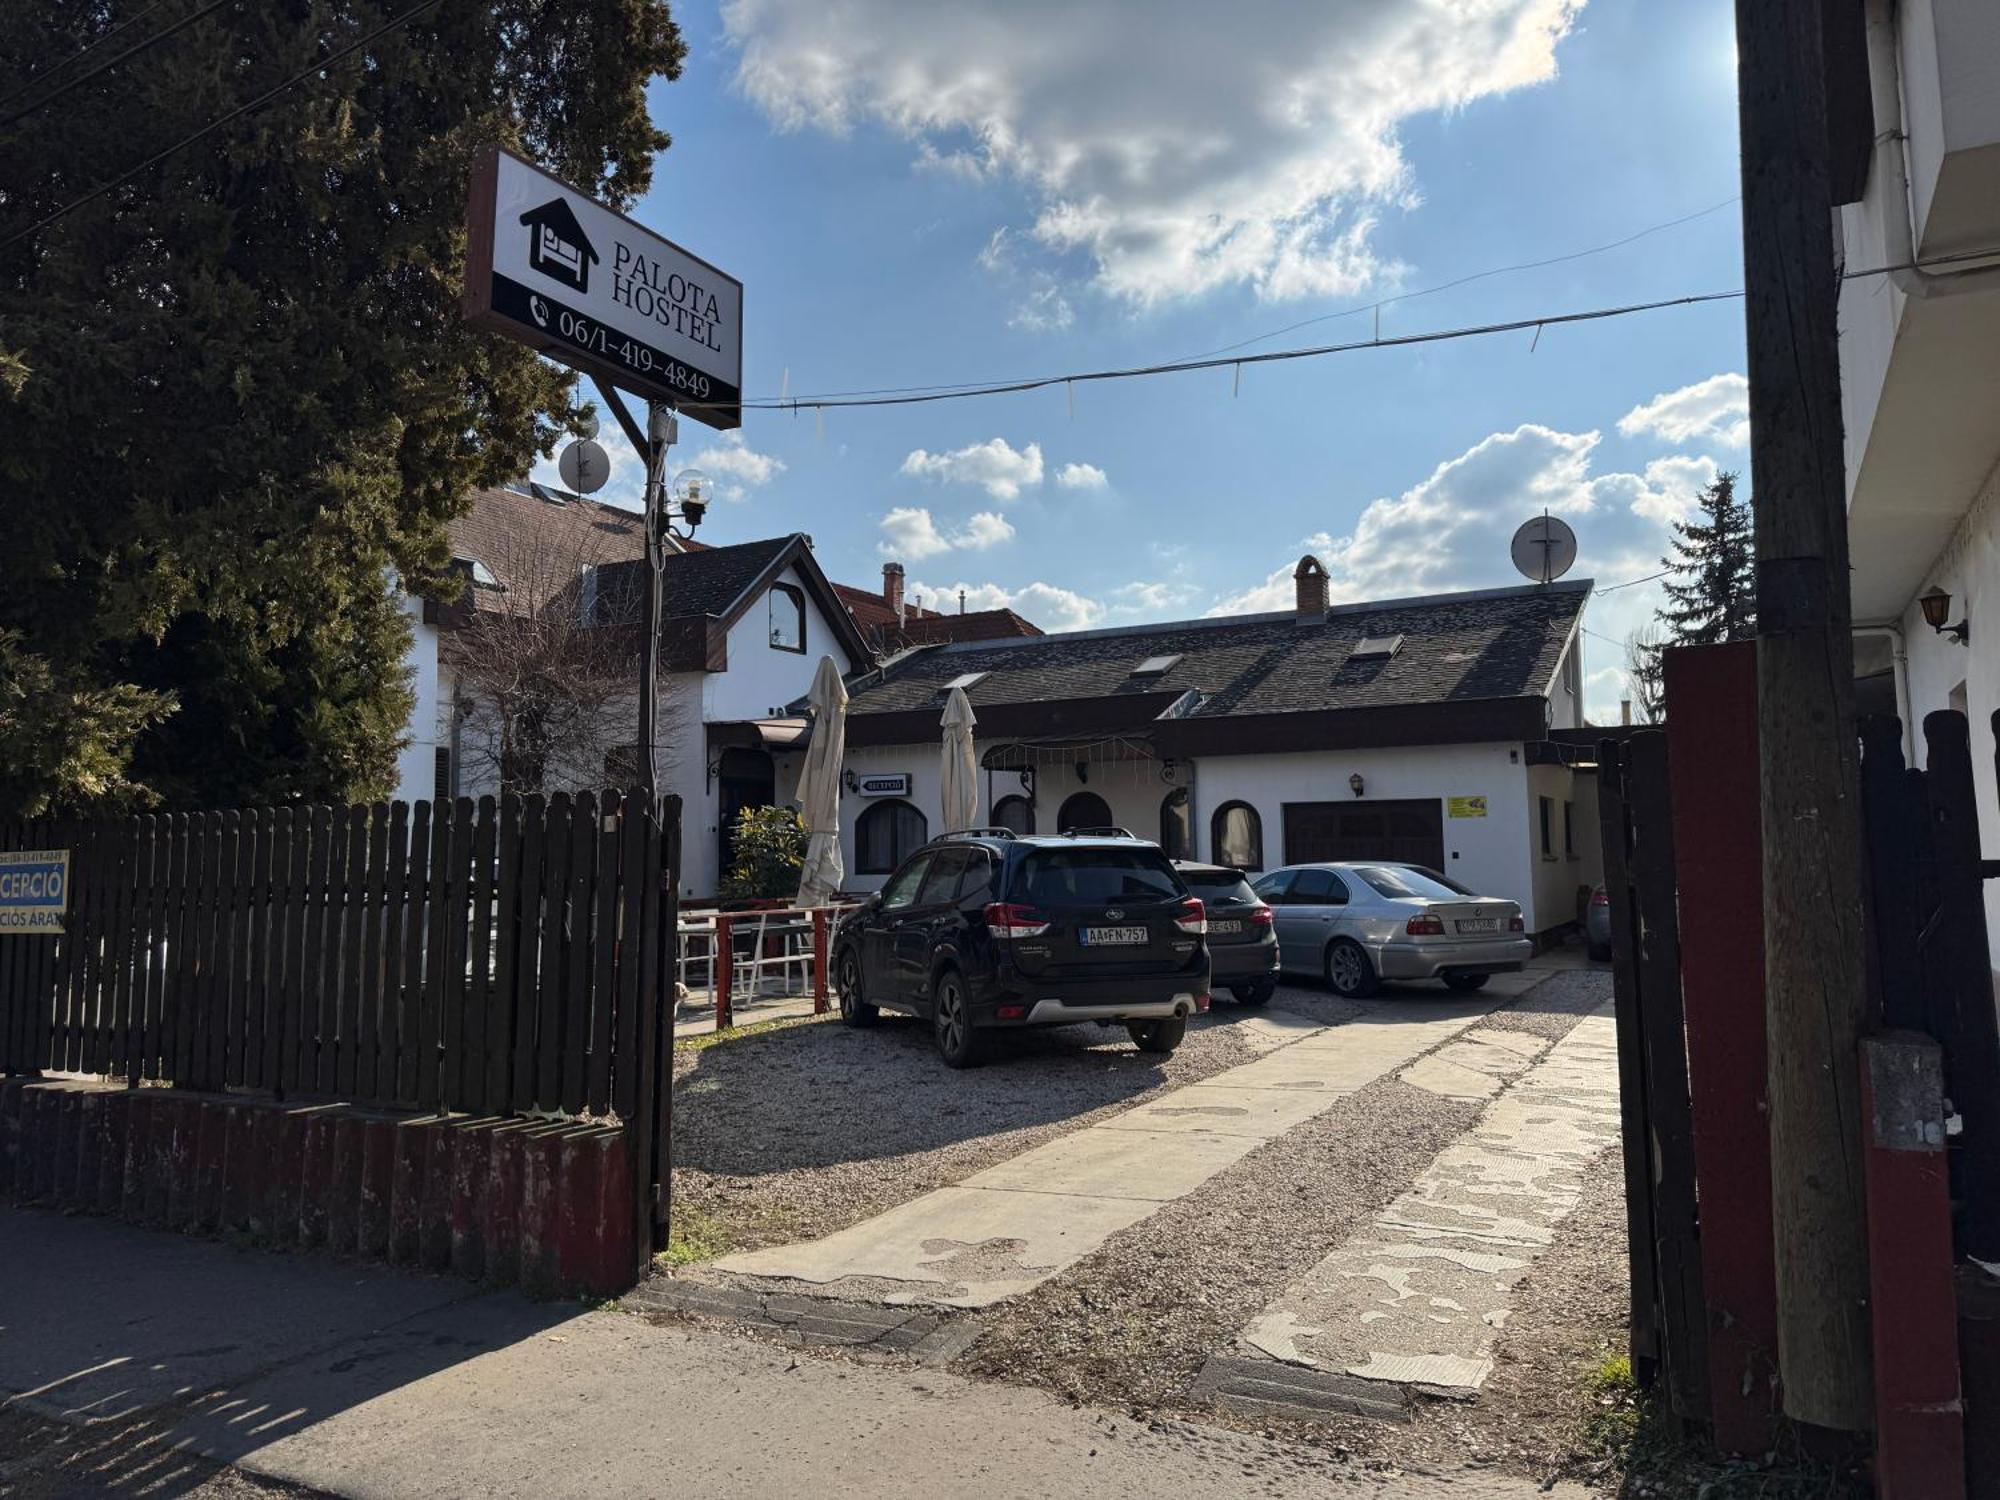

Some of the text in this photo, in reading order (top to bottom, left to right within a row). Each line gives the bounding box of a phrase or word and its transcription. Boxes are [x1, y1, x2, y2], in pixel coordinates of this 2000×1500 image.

[611, 271, 721, 352] HOSTEL
[613, 241, 721, 324] PALOTA
[559, 311, 710, 399] 06/1-419-4849
